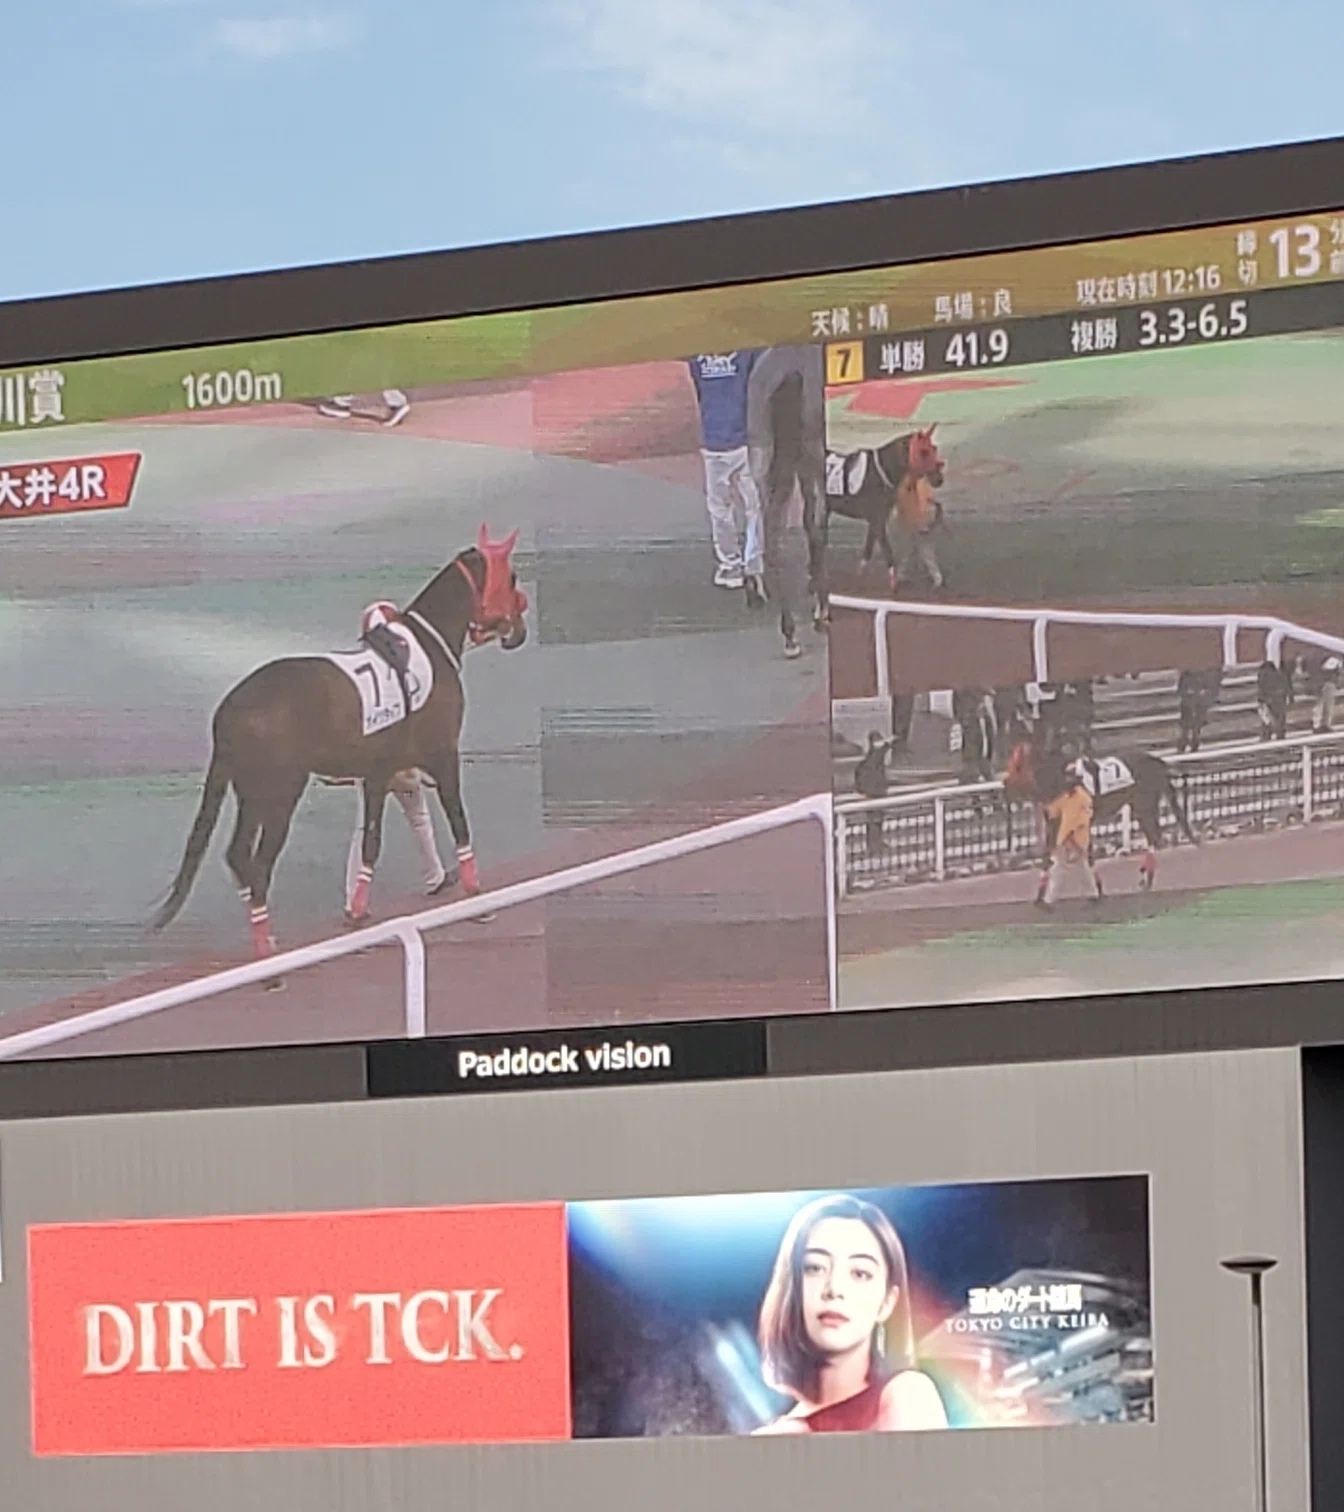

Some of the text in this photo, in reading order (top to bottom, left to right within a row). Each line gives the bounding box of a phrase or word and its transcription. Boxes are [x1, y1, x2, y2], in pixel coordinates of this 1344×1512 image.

[1269, 224, 1321, 279] 13
[1076, 264, 1221, 305] 現在時刻 12:16
[835, 299, 1249, 379] 7 単勝 41.9 複勝 3.3-6.5
[181, 369, 282, 408] 1600m
[354, 662, 381, 708] 7
[458, 1041, 672, 1078] Paddock vision
[83, 1287, 526, 1376] DIRT IS TCK.
[945, 1311, 1110, 1334] TOKYO CITY KEIBA
